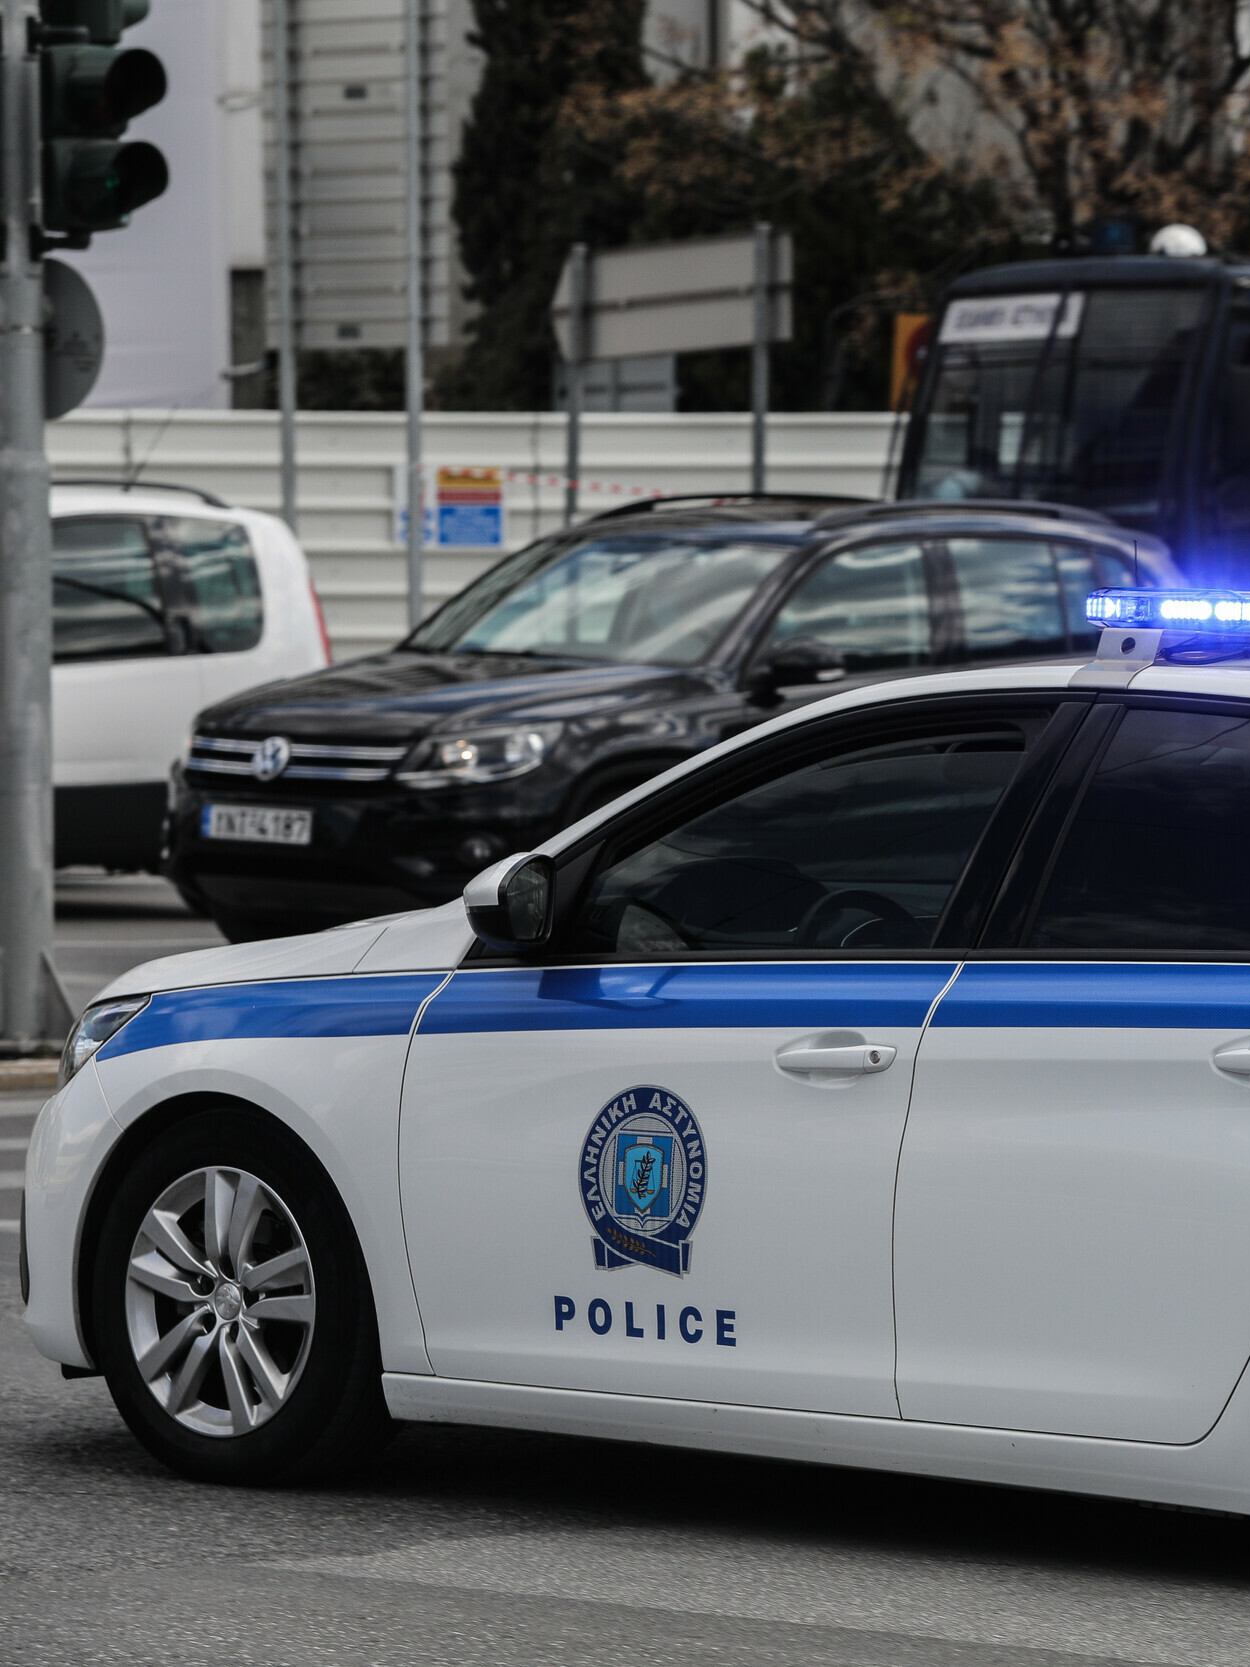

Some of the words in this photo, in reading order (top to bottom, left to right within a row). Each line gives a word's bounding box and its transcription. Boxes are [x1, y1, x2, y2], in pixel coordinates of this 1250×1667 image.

[583, 1093, 638, 1222] ΕΛΛΗΝΙΚΗ
[648, 1092, 704, 1229] ΑΣΤΥΝΟΜΙΑ
[553, 1295, 737, 1347] POLICE
